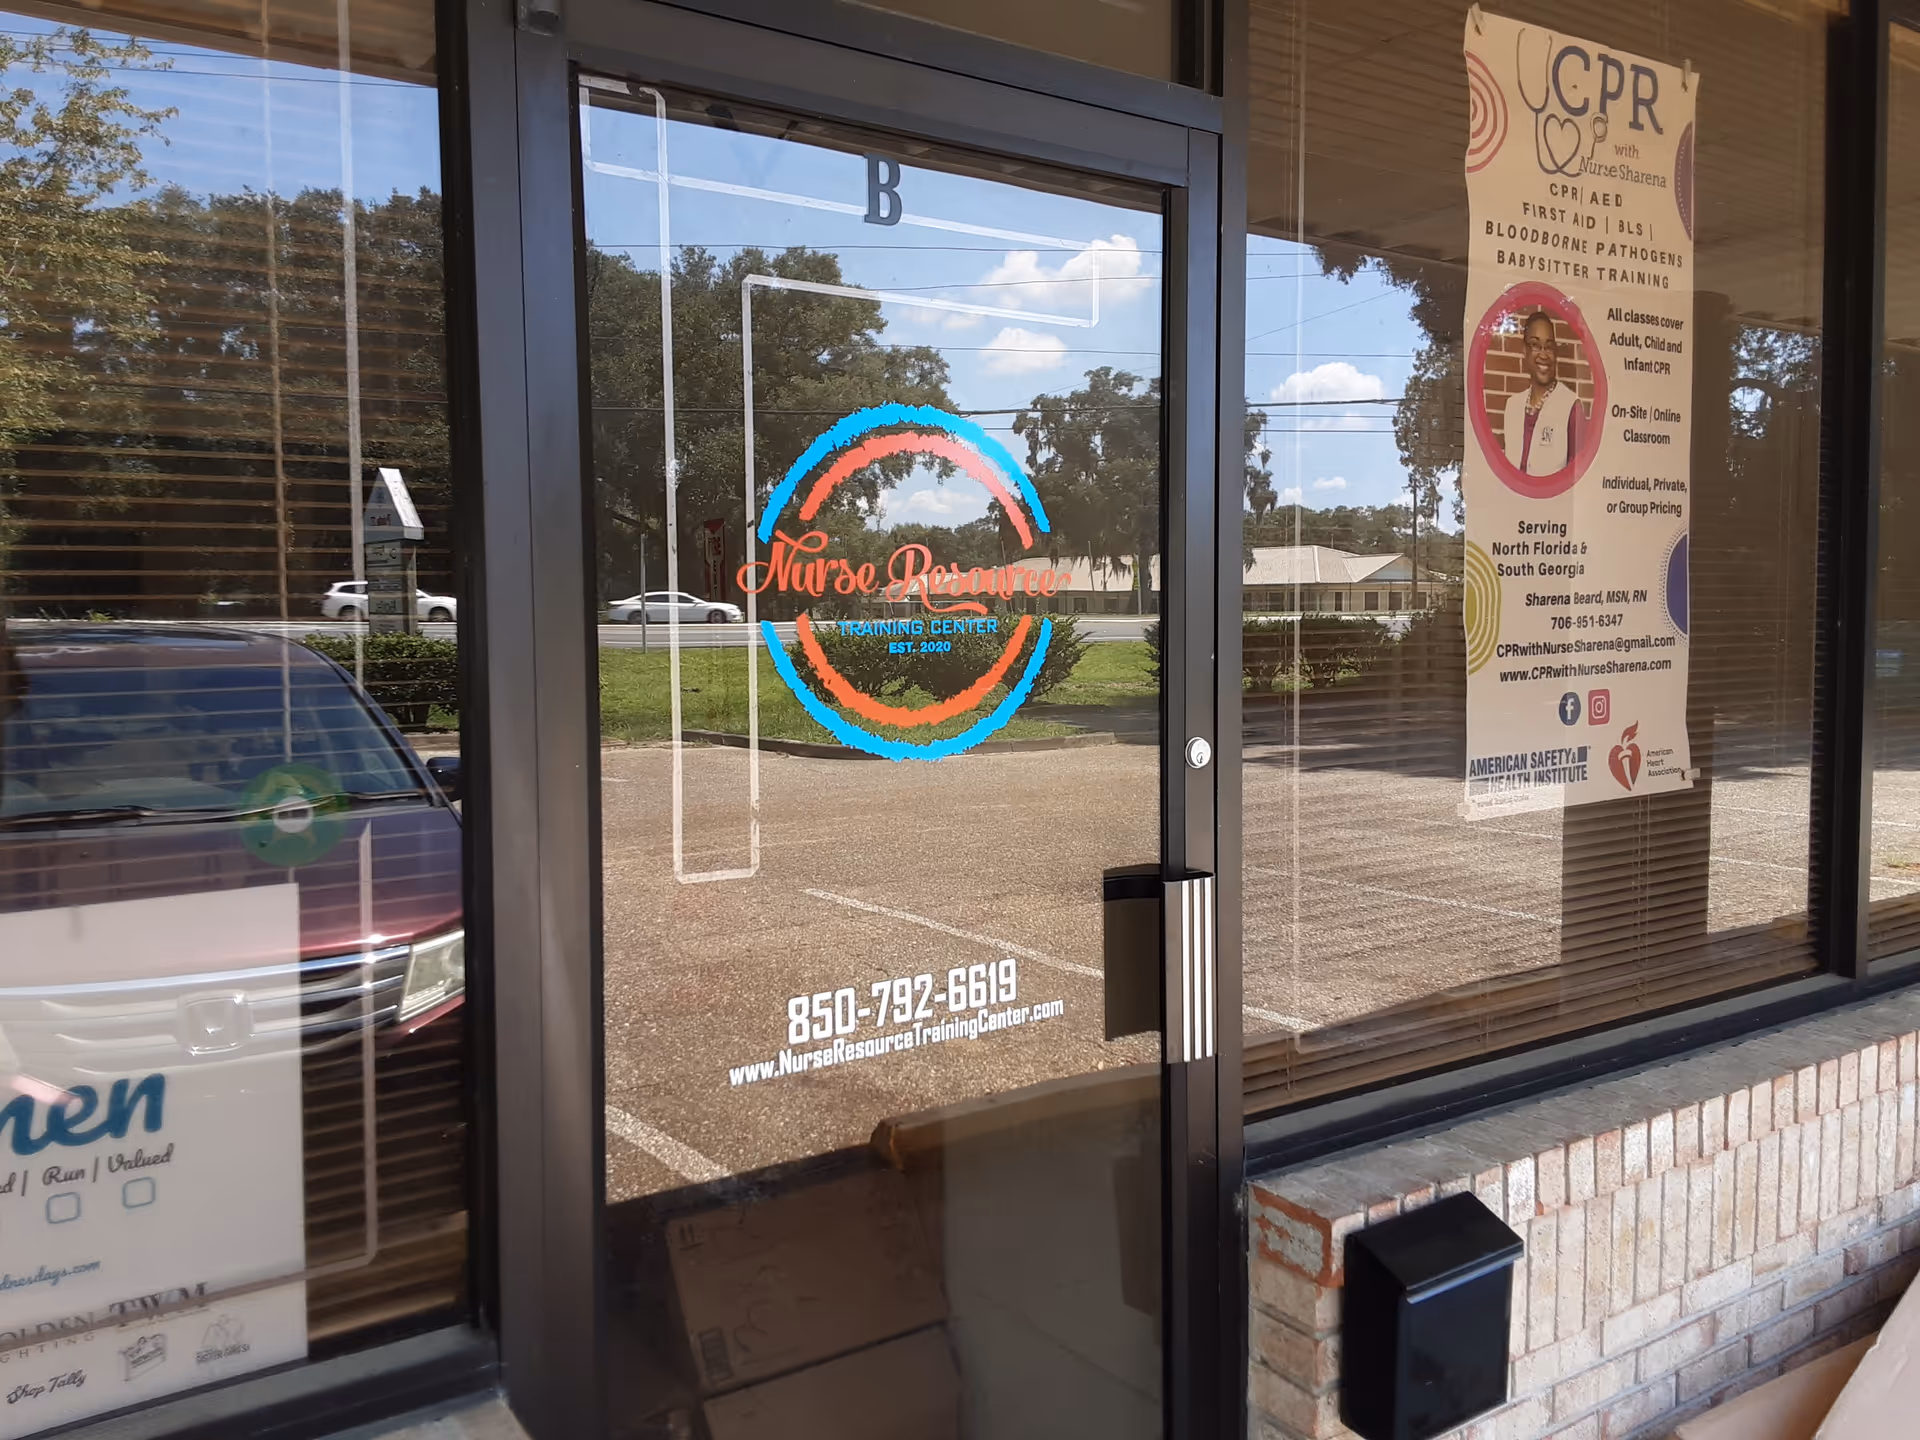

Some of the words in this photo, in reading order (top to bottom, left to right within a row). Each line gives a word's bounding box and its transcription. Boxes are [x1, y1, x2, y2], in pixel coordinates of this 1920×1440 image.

[1552, 46, 1664, 135] CPR
[1614, 144, 1640, 160] with
[864, 153, 903, 226] B
[1590, 190, 1623, 208] AED
[1522, 201, 1566, 223] FIRST
[1572, 212, 1596, 230] AID
[1618, 219, 1643, 236] BLS
[1485, 220, 1588, 255] BLOODBORNE
[1595, 242, 1683, 268] PATHOGENS
[1497, 250, 1589, 279] BABYSITTER
[1597, 267, 1669, 289] TRAINING
[1607, 307, 1622, 322] All
[1624, 309, 1660, 327] classes
[1660, 317, 1684, 330] cover
[1609, 332, 1642, 350] Adult,
[1644, 335, 1665, 351] Child
[1666, 341, 1682, 353] and
[1624, 357, 1652, 373] Infant
[1653, 361, 1671, 375] CPR
[1611, 404, 1647, 420] On-Site
[1653, 408, 1681, 423] Online
[1623, 429, 1671, 445] Classroom
[1602, 476, 1651, 492] Individual,
[1653, 478, 1688, 494] Private,
[1606, 503, 1617, 514] or
[1618, 501, 1648, 517] Group
[1649, 501, 1682, 518] Pricing
[1517, 520, 1567, 538] Serving
[1492, 542, 1530, 556] North
[1533, 542, 1578, 555] Florida
[736, 529, 881, 597] Nurse
[885, 543, 1072, 615] Resource
[1497, 563, 1535, 578] South
[1538, 562, 1585, 579] Georgia
[1525, 592, 1571, 607] Sharena
[1573, 591, 1604, 606] Beard,
[1606, 590, 1631, 605] MSN,
[1632, 589, 1648, 603] RN
[837, 619, 923, 636] TRAINING
[930, 619, 998, 635] CENTER
[1551, 614, 1623, 630] 706-951-6347
[888, 643, 917, 654] EST.
[920, 641, 951, 653] 2020
[1496, 635, 1676, 658] CPRwithNurseSharena@gmail.com
[1499, 658, 1672, 683] www.CPRwithNurseSharena.com
[1647, 748, 1674, 757] American
[1469, 752, 1528, 778] AMERICAN
[1646, 759, 1664, 767] Heart
[1648, 767, 1681, 777] Association
[1490, 770, 1531, 793] HEALTH
[1534, 764, 1588, 787] INSTITUTE
[787, 958, 1017, 1045] 850-792-6619
[729, 998, 1064, 1086] www.NurseResourceTrainingCenter.com
[42, 1166, 86, 1186] Run
[107, 1143, 175, 1173] Valued
[7, 1383, 46, 1404] Shop
[49, 1369, 87, 1393] Tally
